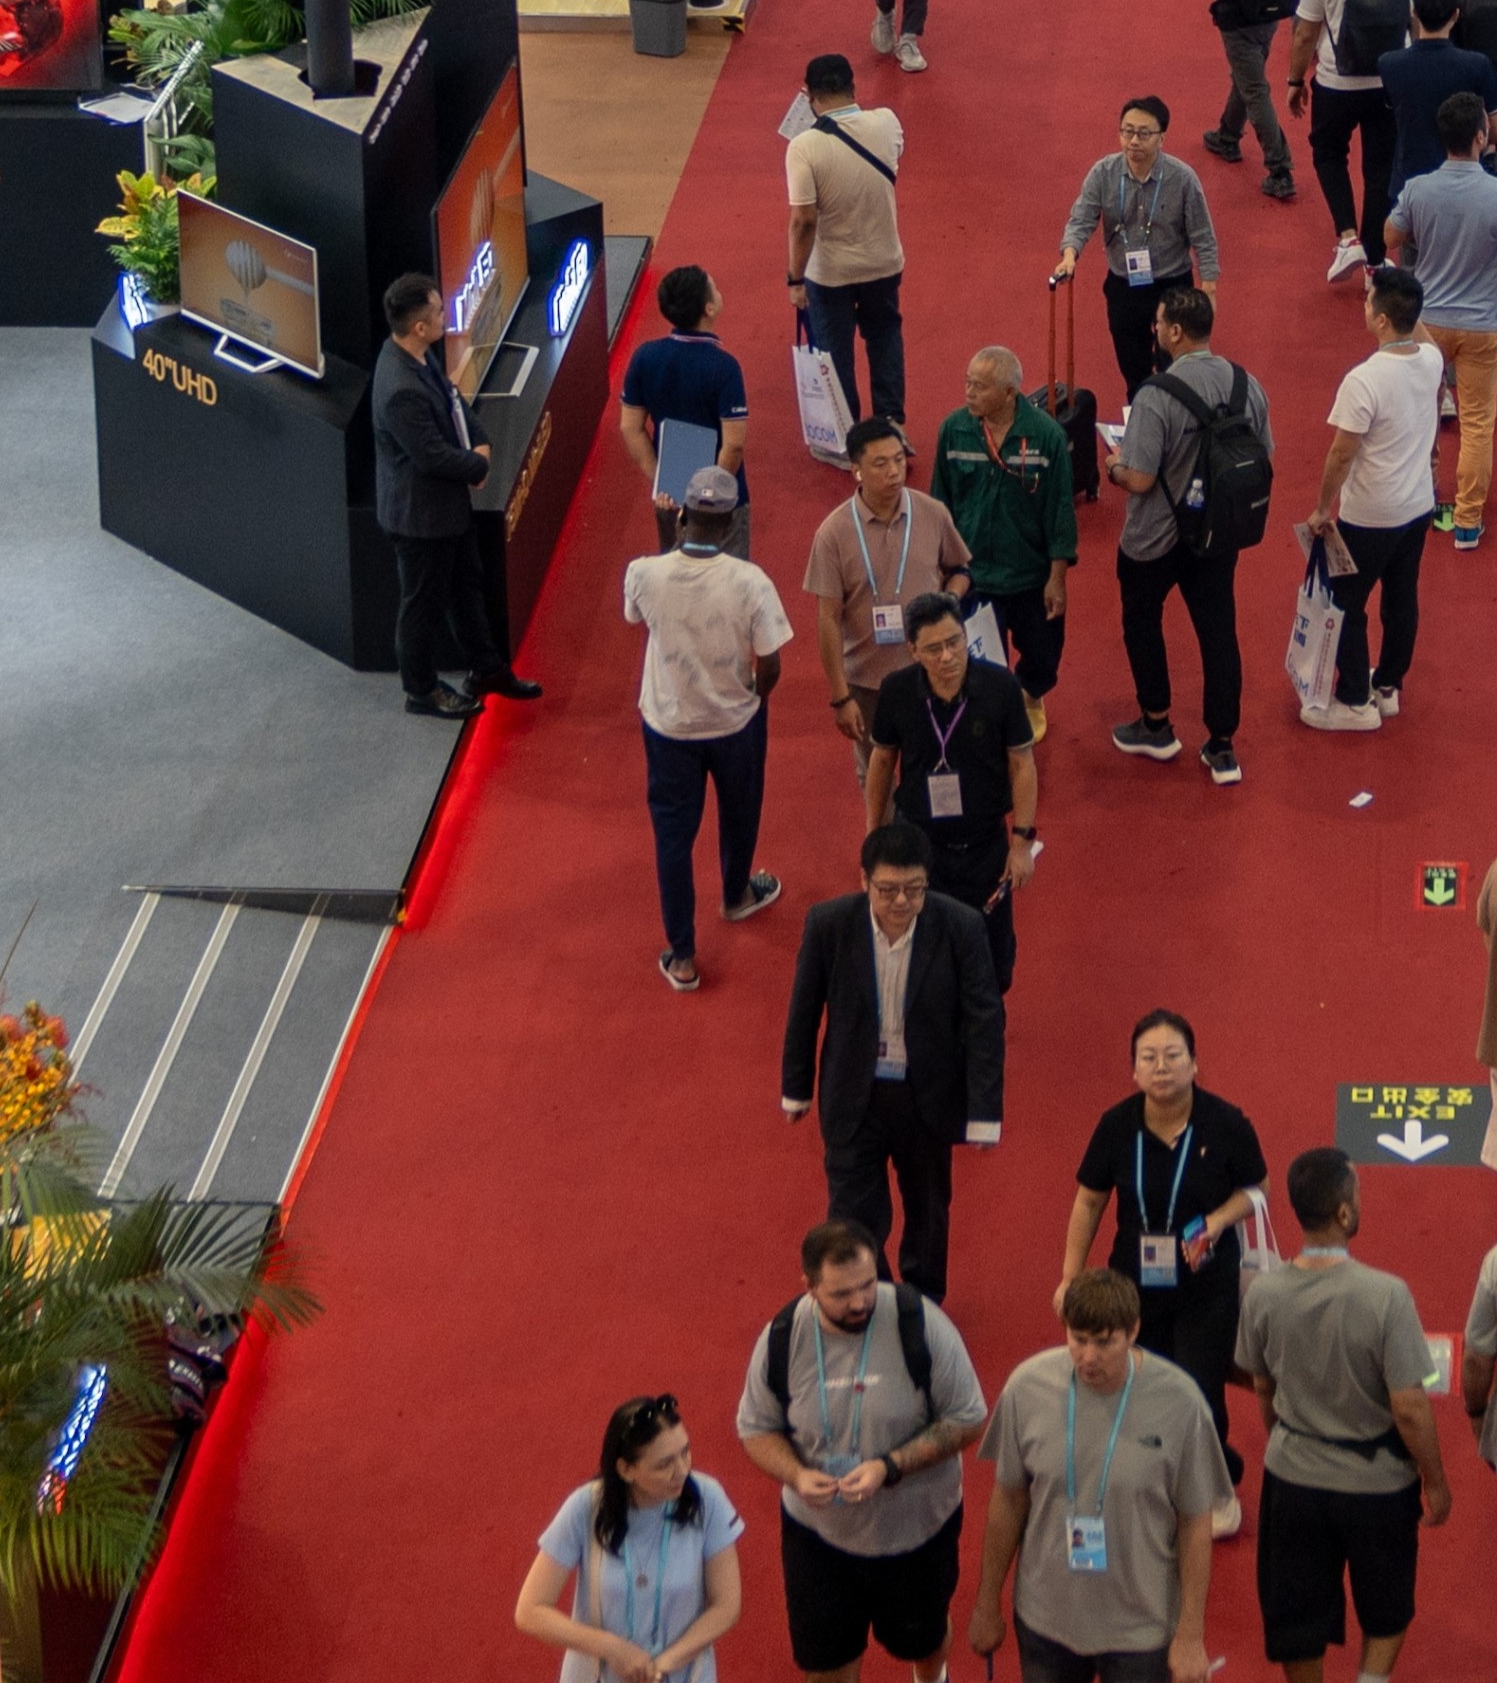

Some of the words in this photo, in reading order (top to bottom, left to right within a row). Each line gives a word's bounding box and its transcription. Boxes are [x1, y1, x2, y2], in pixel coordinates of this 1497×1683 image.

[142, 347, 219, 407] 40"UHD
[1350, 1086, 1474, 1106] 安全出口
[1368, 1104, 1456, 1120] EXIT
